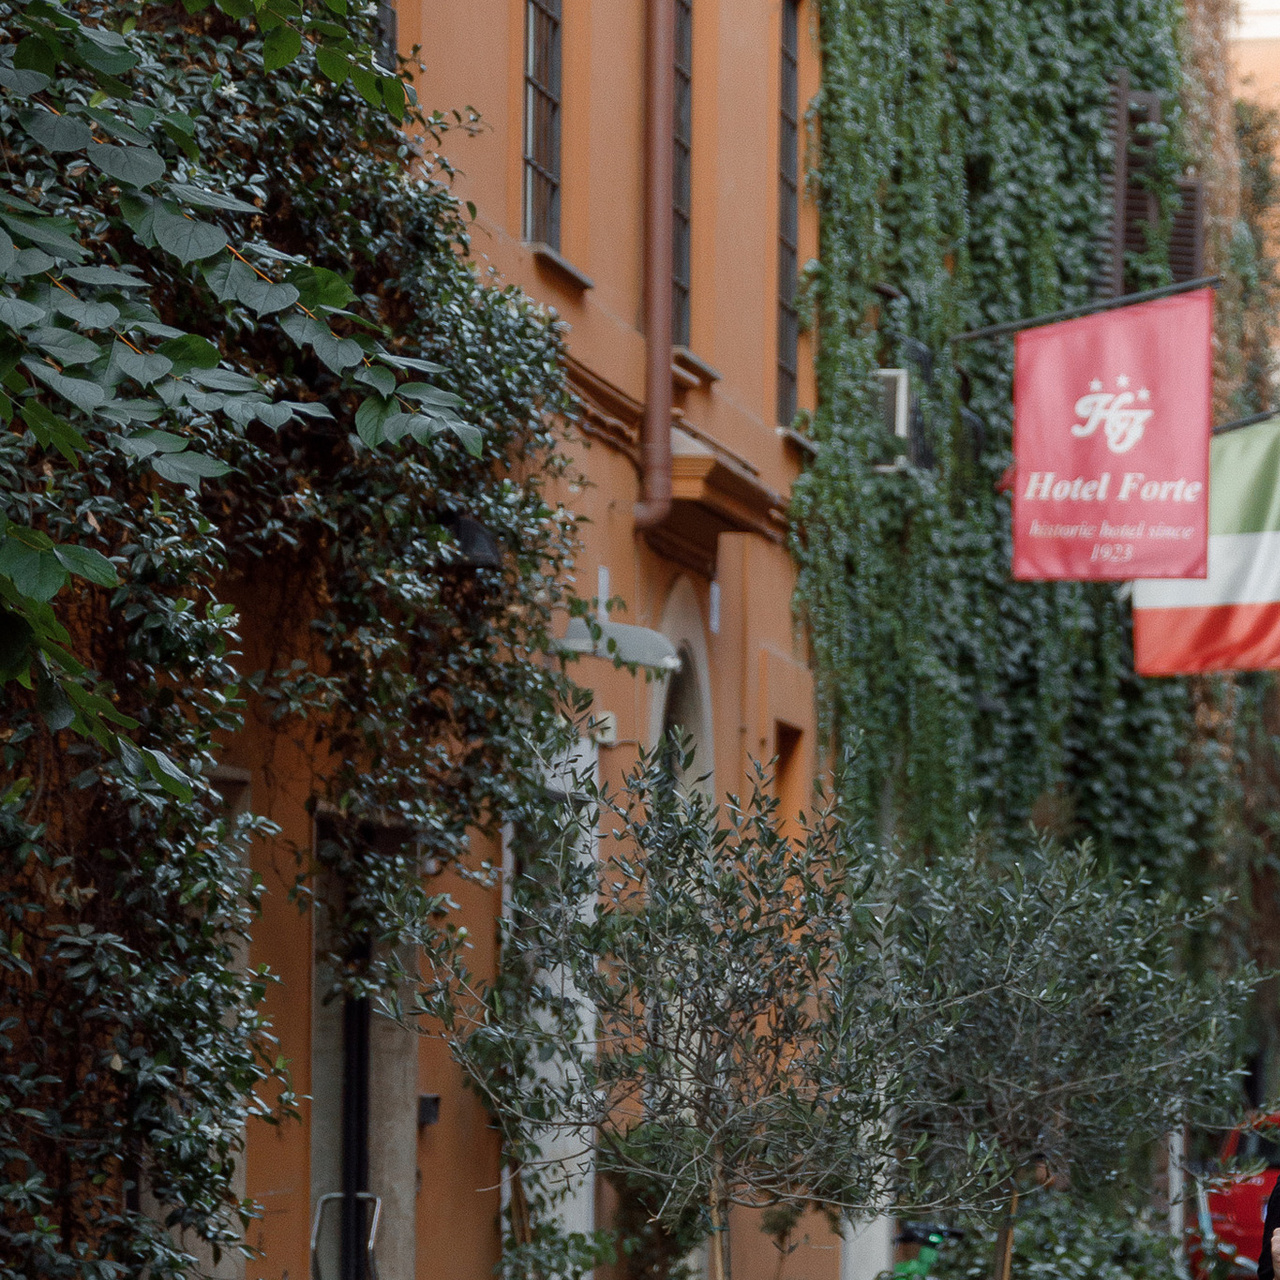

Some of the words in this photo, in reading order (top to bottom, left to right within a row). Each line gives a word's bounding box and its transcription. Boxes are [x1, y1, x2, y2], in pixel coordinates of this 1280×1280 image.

[1024, 472, 1111, 501] Hotel
[1117, 472, 1203, 502] Forte
[1029, 519, 1097, 539] historic
[1099, 519, 1146, 539] hotel
[1148, 521, 1195, 540] since
[1090, 543, 1135, 563] 1923
